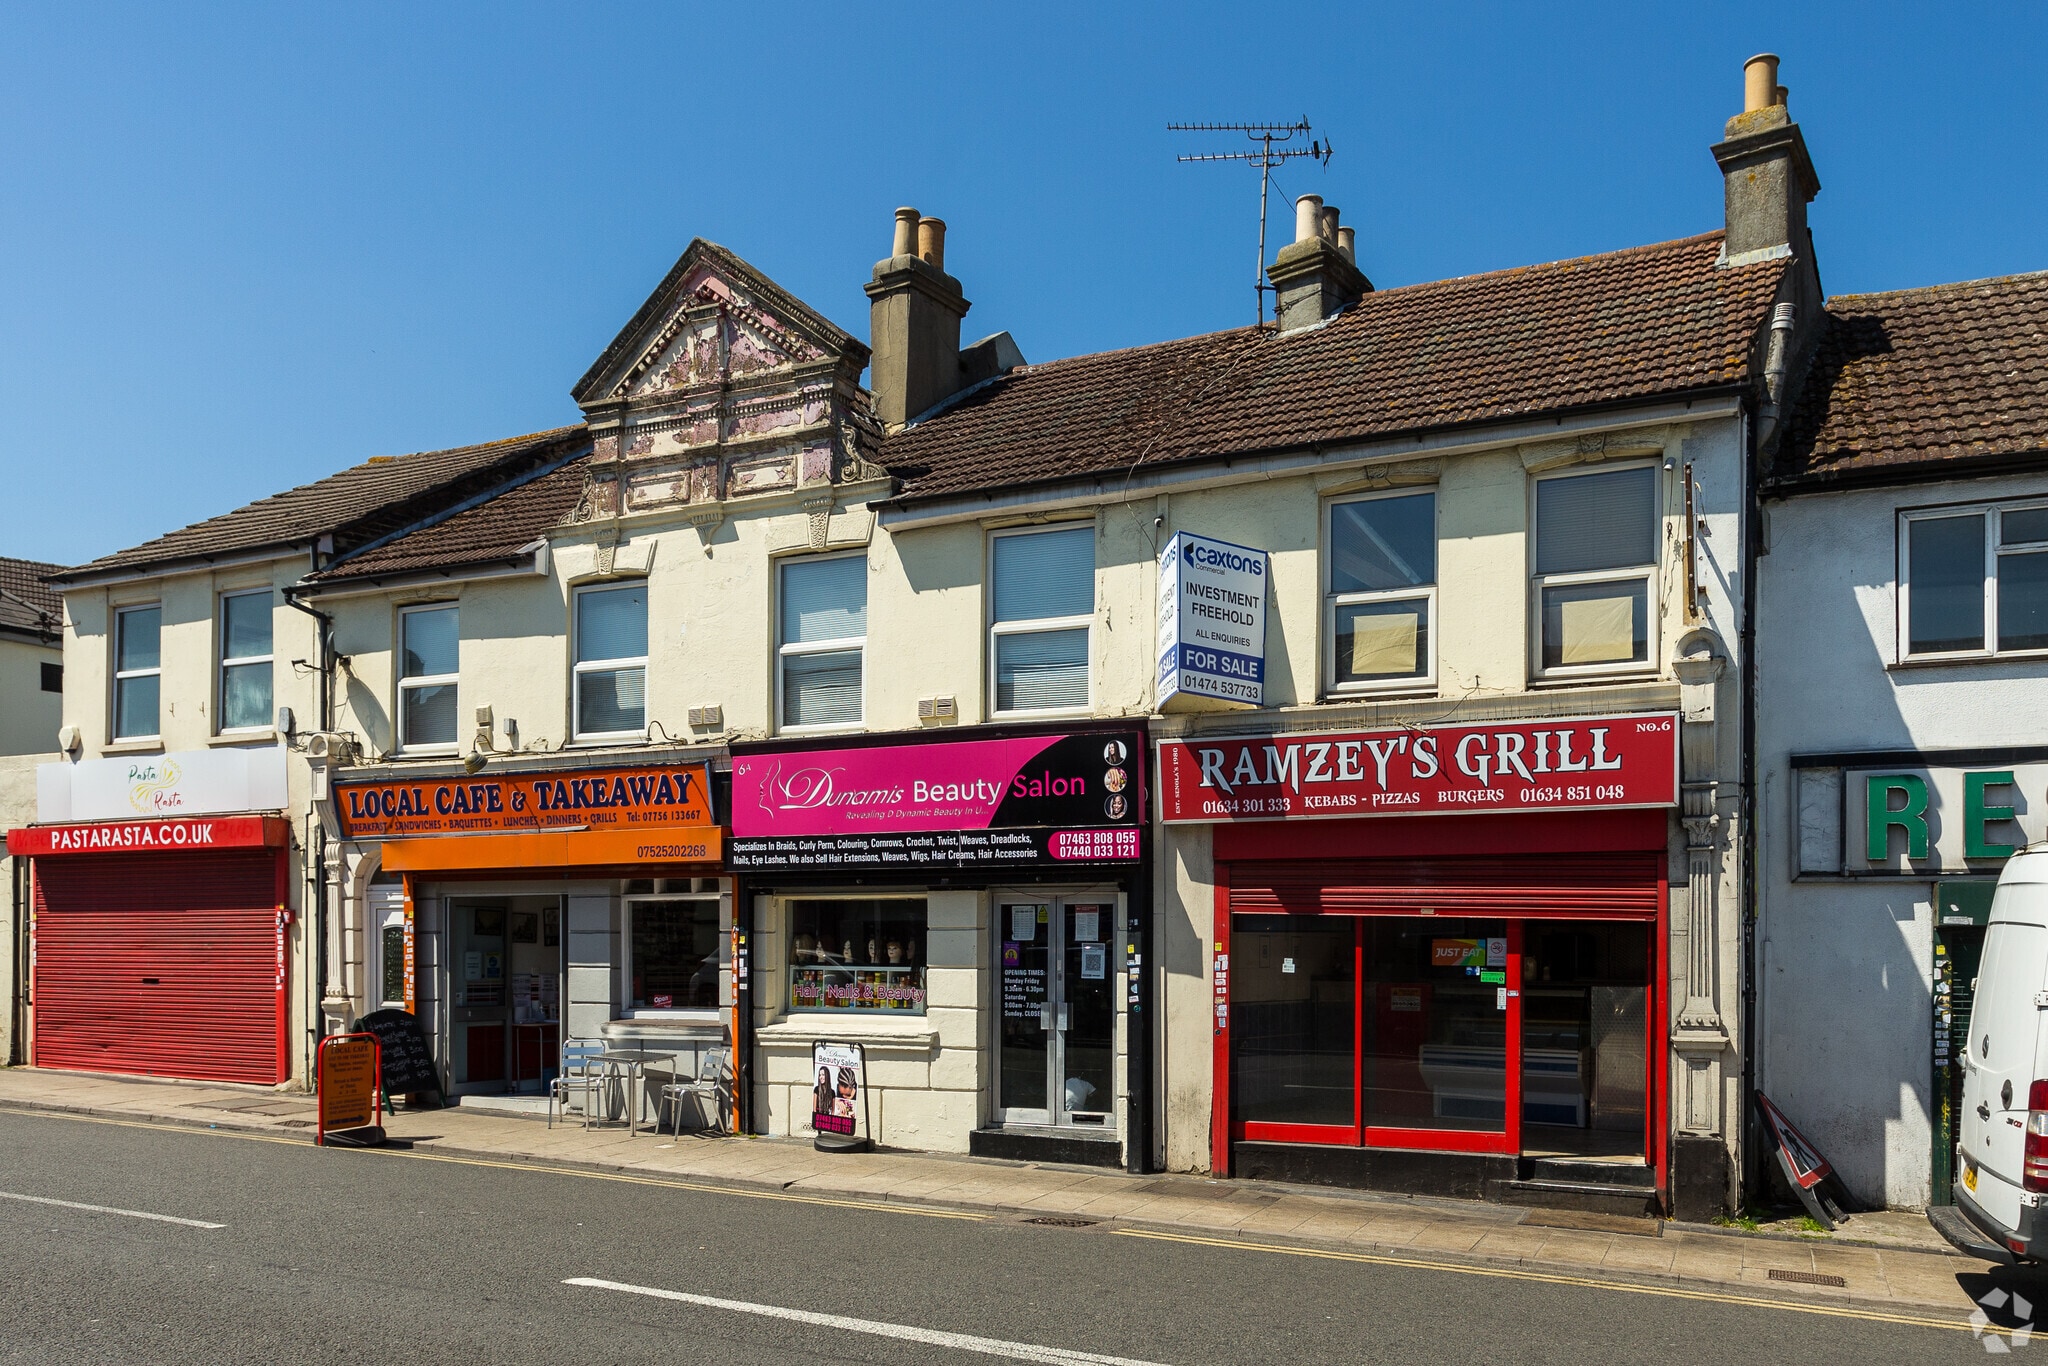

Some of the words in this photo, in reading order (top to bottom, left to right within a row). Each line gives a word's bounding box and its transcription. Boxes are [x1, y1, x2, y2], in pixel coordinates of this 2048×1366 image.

[1195, 546, 1263, 576] caxtons
[1195, 562, 1226, 576] Commercial
[1185, 581, 1260, 609] INVESTMENT
[1191, 602, 1254, 626] FREEHOLD
[1195, 628, 1210, 639] ALL
[1211, 631, 1251, 647] ENQUIRIES
[1186, 649, 1217, 671] FOR
[1221, 656, 1258, 678] SALE
[1184, 674, 1218, 692] 01474
[1220, 681, 1259, 699] 537733
[1635, 720, 1671, 733] NO.6
[1198, 735, 1440, 796] RAMZEY'S
[1453, 727, 1623, 789] GRILL
[128, 764, 159, 784] Pasta
[1172, 766, 1180, 798] SENOLA'S
[348, 788, 429, 819] LOCAL
[434, 783, 504, 816] CAFE
[510, 790, 527, 812] &
[532, 773, 693, 811] TAKEAWAY
[778, 767, 904, 810] Dunamis
[913, 778, 1002, 806] Beauty
[1012, 770, 1085, 798] Salon
[1520, 787, 1563, 803] 01634
[1566, 785, 1591, 801] 851
[1595, 784, 1625, 800] 048
[154, 790, 184, 811] Rasta
[1203, 799, 1239, 814] 01634
[1242, 798, 1265, 813] 301
[1268, 797, 1291, 812] 333
[1304, 794, 1357, 809] KEBABS
[1371, 791, 1421, 808] PIZZAS
[1437, 789, 1505, 804] BURGERS
[350, 821, 388, 833] BREAKFAST
[395, 819, 442, 831] SANDWICHES
[503, 815, 539, 827] LUNCHES
[546, 813, 582, 825] DINNERS
[590, 812, 618, 825] GRILLS
[626, 811, 641, 822] Tel:
[642, 810, 668, 822] 07756
[670, 809, 701, 821] 133667
[845, 811, 885, 820] Revealing
[887, 809, 894, 817] D
[895, 807, 931, 818] Dynamic
[933, 807, 962, 817] Beauty
[965, 806, 973, 815] In
[1866, 770, 2048, 861] RE
[51, 823, 213, 850] PASTARASTA.CO.UK
[733, 842, 767, 853] Specializes
[768, 841, 775, 851] In
[776, 841, 798, 851] Braids,
[799, 840, 816, 852] Curly
[817, 840, 835, 850] Perm,
[837, 839, 870, 851] Colouring,
[870, 838, 904, 849] Cornrows,
[905, 836, 936, 847] Crochet,
[937, 835, 959, 846] Twist,
[959, 834, 989, 845] Weaves,
[990, 833, 1033, 844] Dreadlocks,
[1059, 833, 1091, 845] 07463
[1093, 832, 1113, 844] 808
[1116, 831, 1136, 844] 055
[637, 844, 706, 858] 07525202268
[733, 855, 751, 866] Nails,
[752, 855, 763, 866] Eye
[764, 854, 788, 864] Lashes.
[789, 854, 800, 864] We
[801, 854, 814, 864] also
[815, 853, 828, 863] Sell
[829, 853, 843, 863] Hair
[843, 852, 881, 863] Extensions,
[881, 851, 910, 862] Weaves,
[910, 850, 930, 863] Wigs,
[931, 850, 946, 860] Hair
[947, 849, 977, 860] Creams,
[978, 848, 993, 859] Hair
[994, 848, 1038, 859] Accessories
[1059, 846, 1091, 858] 07440
[1093, 845, 1113, 857] 033
[1116, 844, 1135, 857] 121
[1436, 947, 1461, 958] JUST
[1462, 947, 1482, 957] EAT
[1004, 977, 1023, 985] Monday
[1024, 977, 1040, 985] Friday
[793, 983, 824, 1000] Hair,
[827, 983, 860, 999] Nails
[862, 985, 873, 999] &
[876, 986, 927, 1003] Beauty
[1004, 993, 1026, 1001] Saturday
[818, 1054, 841, 1066] Beauty
[840, 1058, 859, 1069] Salon
